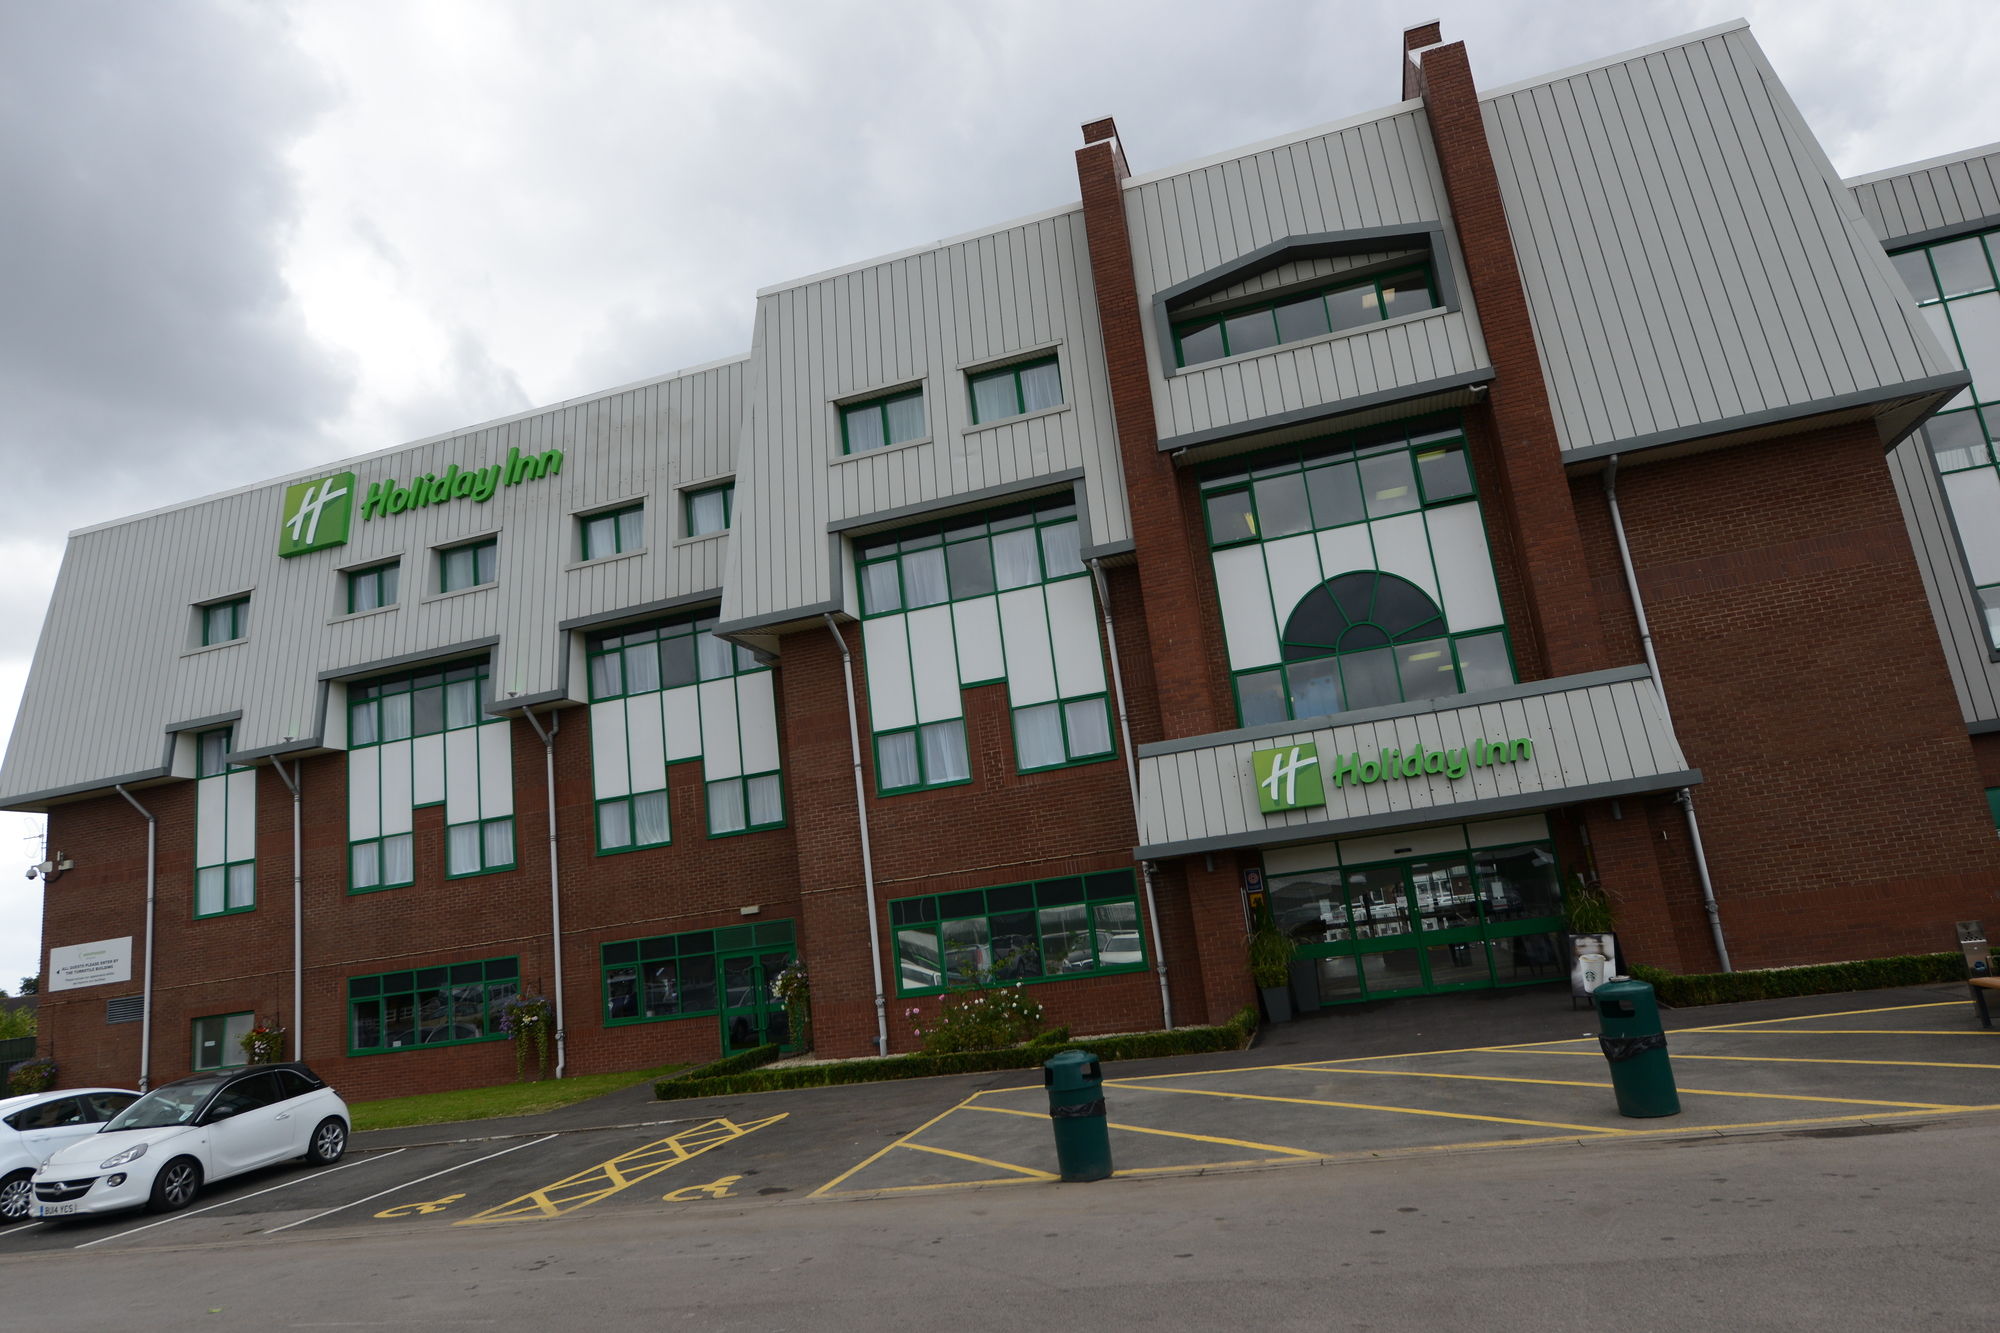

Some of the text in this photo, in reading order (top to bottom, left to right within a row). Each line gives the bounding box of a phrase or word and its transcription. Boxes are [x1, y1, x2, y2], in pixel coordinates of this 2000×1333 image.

[361, 446, 564, 521] Holiday Inn
[1332, 737, 1533, 788] Holiday Inn
